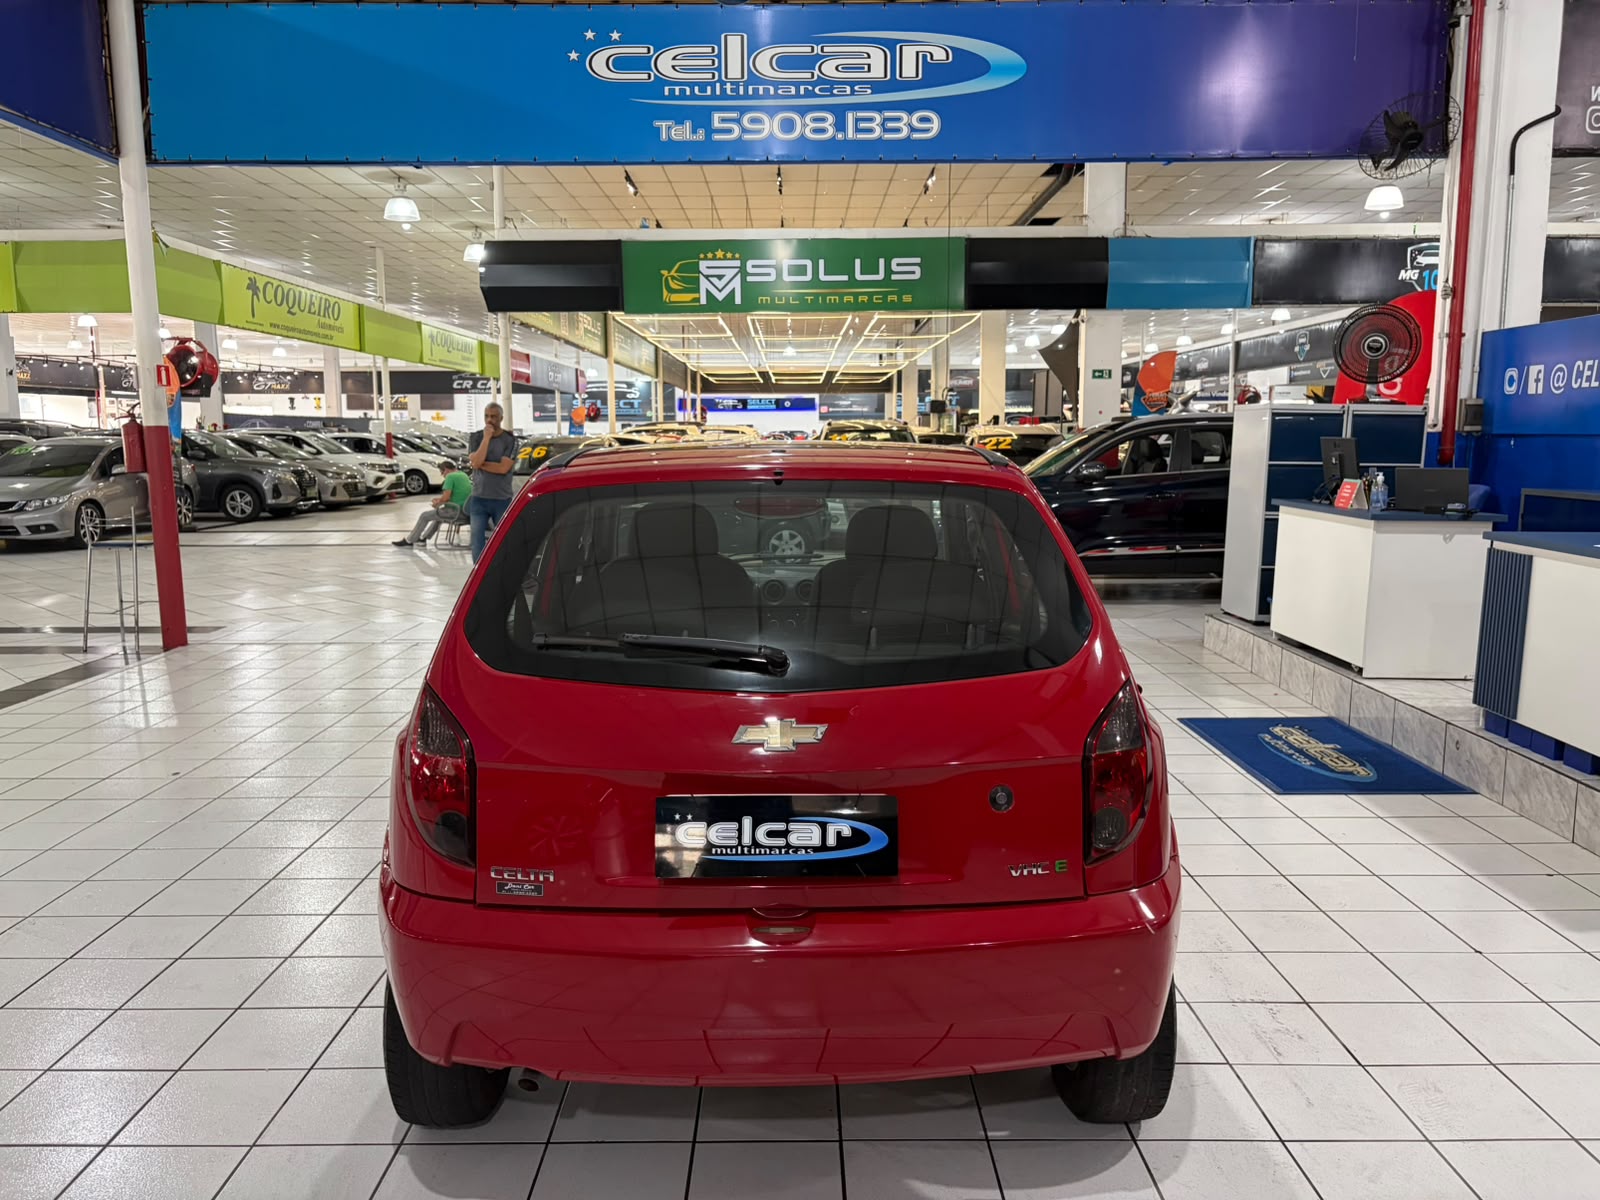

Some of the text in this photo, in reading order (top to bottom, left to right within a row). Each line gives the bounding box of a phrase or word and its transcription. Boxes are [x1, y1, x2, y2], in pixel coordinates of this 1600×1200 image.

[585, 33, 953, 83] celcar
[663, 83, 872, 96] multimarcas
[711, 111, 942, 141] 5908.1339
[746, 257, 922, 282] SOLUS
[1398, 269, 1420, 280] MG
[262, 281, 342, 321] COQUEIRO
[758, 294, 913, 304] MULTIMARCAS
[985, 437, 1012, 449] 22
[517, 446, 548, 459] 26
[675, 816, 852, 847] celcar
[711, 846, 814, 855] multimarcas
[490, 866, 554, 882] CELTA
[1008, 860, 1067, 877] VHC E
